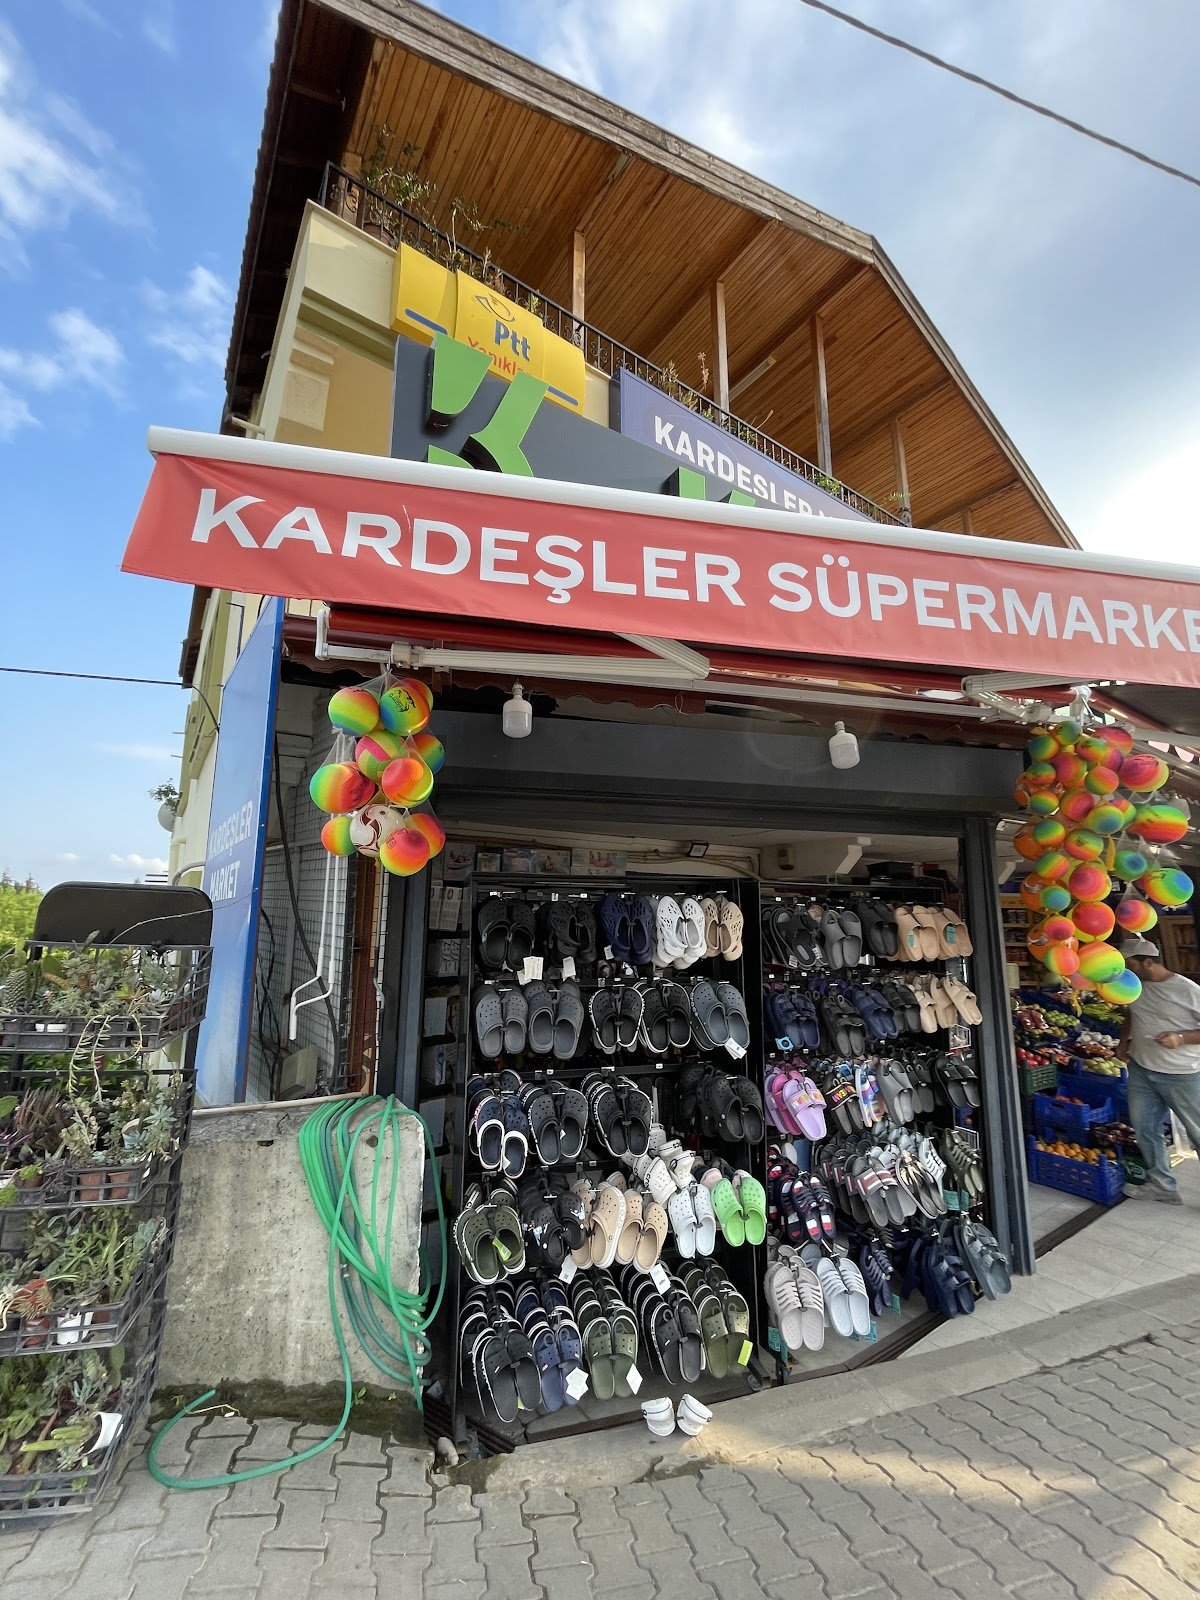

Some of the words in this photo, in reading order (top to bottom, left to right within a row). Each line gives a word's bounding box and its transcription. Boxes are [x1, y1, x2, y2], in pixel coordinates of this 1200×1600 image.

[494, 319, 531, 362] Ptt
[190, 487, 746, 604] KARDEŞLER
[209, 860, 241, 903] MARKET
